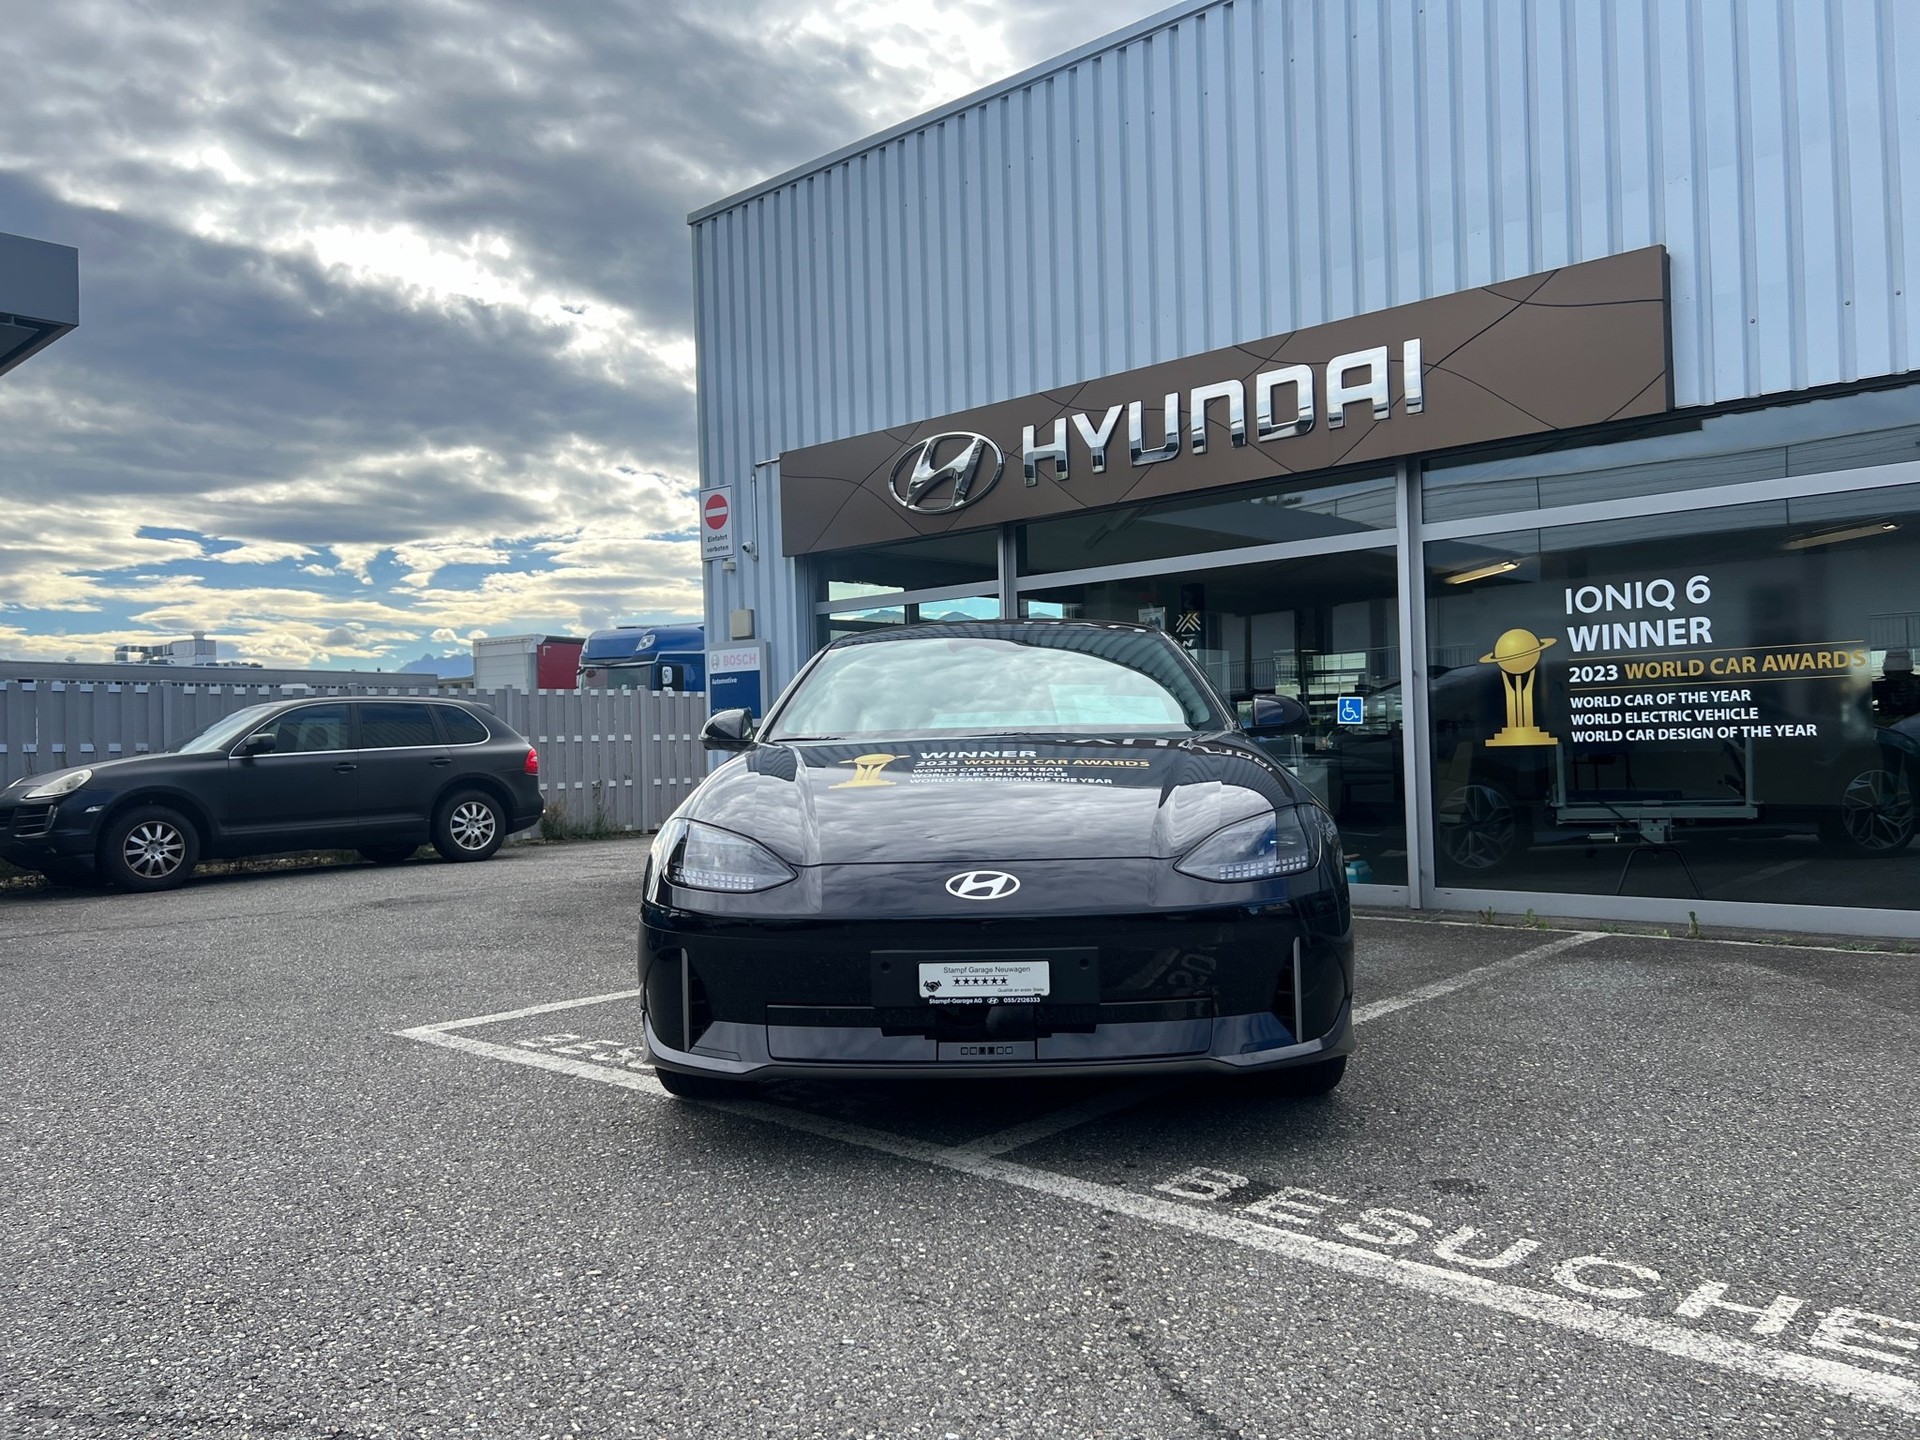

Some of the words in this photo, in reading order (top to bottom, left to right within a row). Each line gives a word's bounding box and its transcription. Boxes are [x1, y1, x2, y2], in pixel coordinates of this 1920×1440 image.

[1021, 337, 1424, 487] HYUNDAI
[707, 534, 728, 542] Einfahrt
[1565, 578, 1676, 614] IONIQ
[1685, 574, 1711, 604] 6
[1566, 616, 1713, 653] WINNER
[723, 653, 757, 666] BOSCH
[1568, 664, 1619, 683] 2023
[1624, 659, 1705, 680] WORLD
[1709, 656, 1757, 675] CAR
[1761, 649, 1867, 672] AWARDS
[711, 676, 738, 685] Automotive
[1569, 695, 1622, 709] WORLD
[1624, 693, 1654, 706] CAR
[1656, 692, 1676, 705] OF
[1678, 691, 1708, 704] THE
[1710, 689, 1751, 703] YEAR
[1570, 712, 1623, 726] WORLD
[1625, 709, 1692, 724] ELECTRIC
[1694, 707, 1759, 722] VEHICLE
[1571, 730, 1623, 743] WORLD
[1625, 729, 1655, 741] CAR
[1657, 726, 1714, 740] DESIGN
[1716, 726, 1738, 739] OF
[1740, 725, 1772, 738] THE
[1774, 723, 1818, 737] YEAR
[920, 750, 1037, 759] WINNER
[943, 966, 967, 974] Stampf
[968, 966, 994, 974] Garage
[995, 965, 1031, 974] Neuwagen
